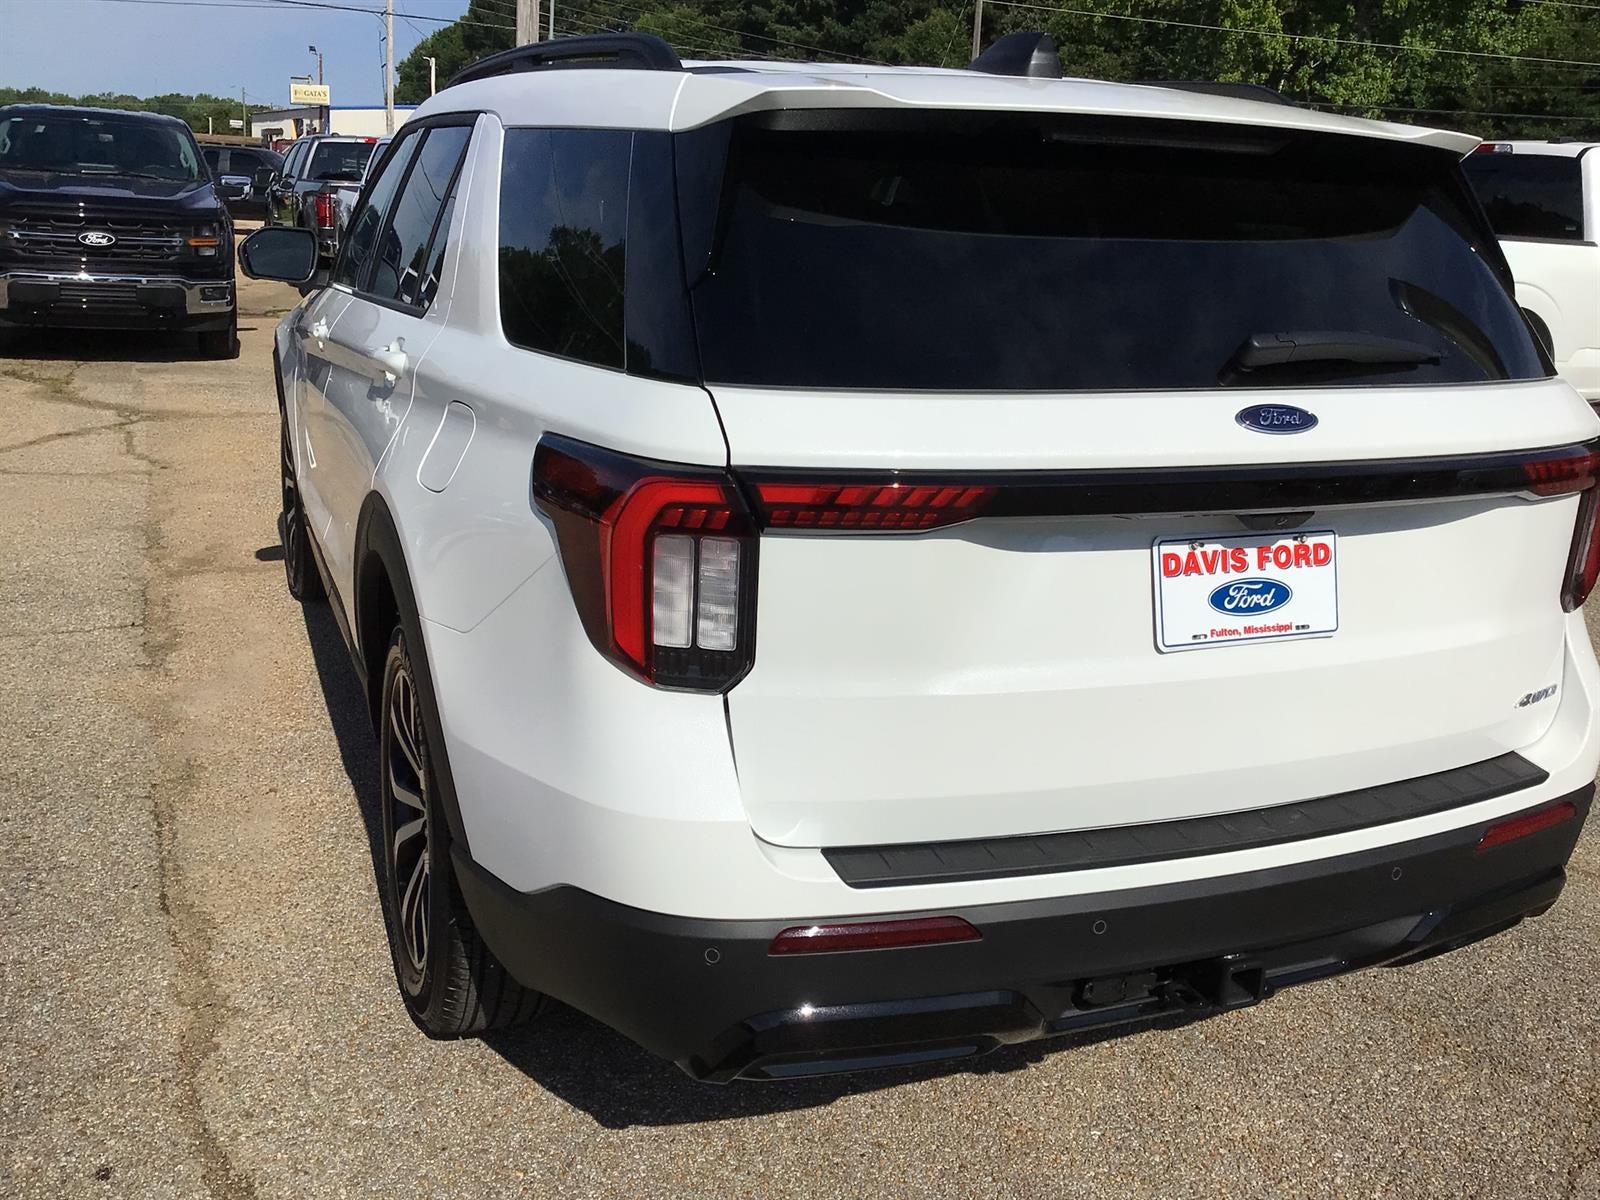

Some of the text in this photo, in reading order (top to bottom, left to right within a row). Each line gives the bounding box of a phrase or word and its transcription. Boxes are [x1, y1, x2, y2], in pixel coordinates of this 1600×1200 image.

[1260, 407, 1302, 425] Ford
[1162, 542, 1332, 577] DAVIS FORD
[1224, 583, 1276, 610] Ford
[1210, 621, 1293, 639] Fulton, Mississippi
